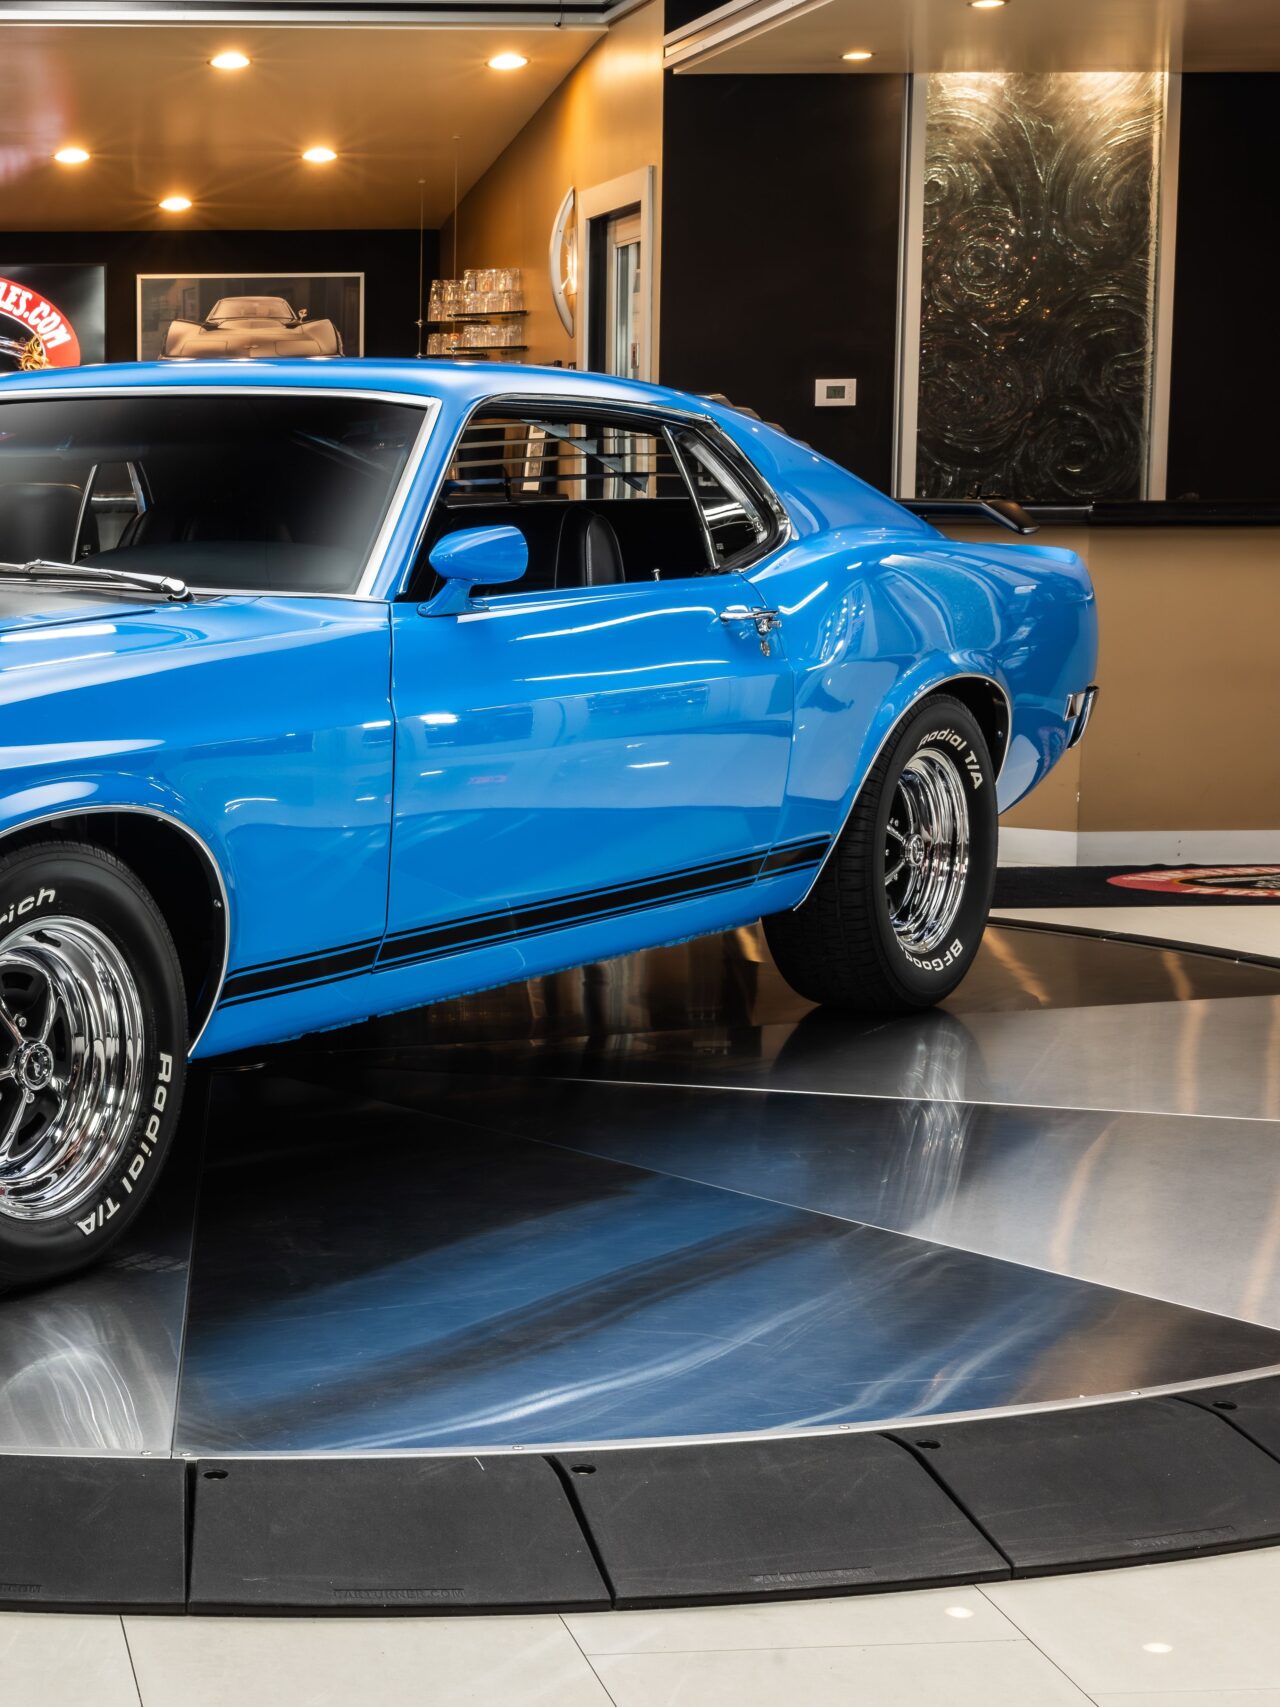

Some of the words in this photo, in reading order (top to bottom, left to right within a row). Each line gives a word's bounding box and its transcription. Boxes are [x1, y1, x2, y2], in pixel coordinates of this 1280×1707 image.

[964, 750, 984, 790] T/A
[121, 1052, 172, 1194] Radial
[75, 1199, 120, 1235] T/A
